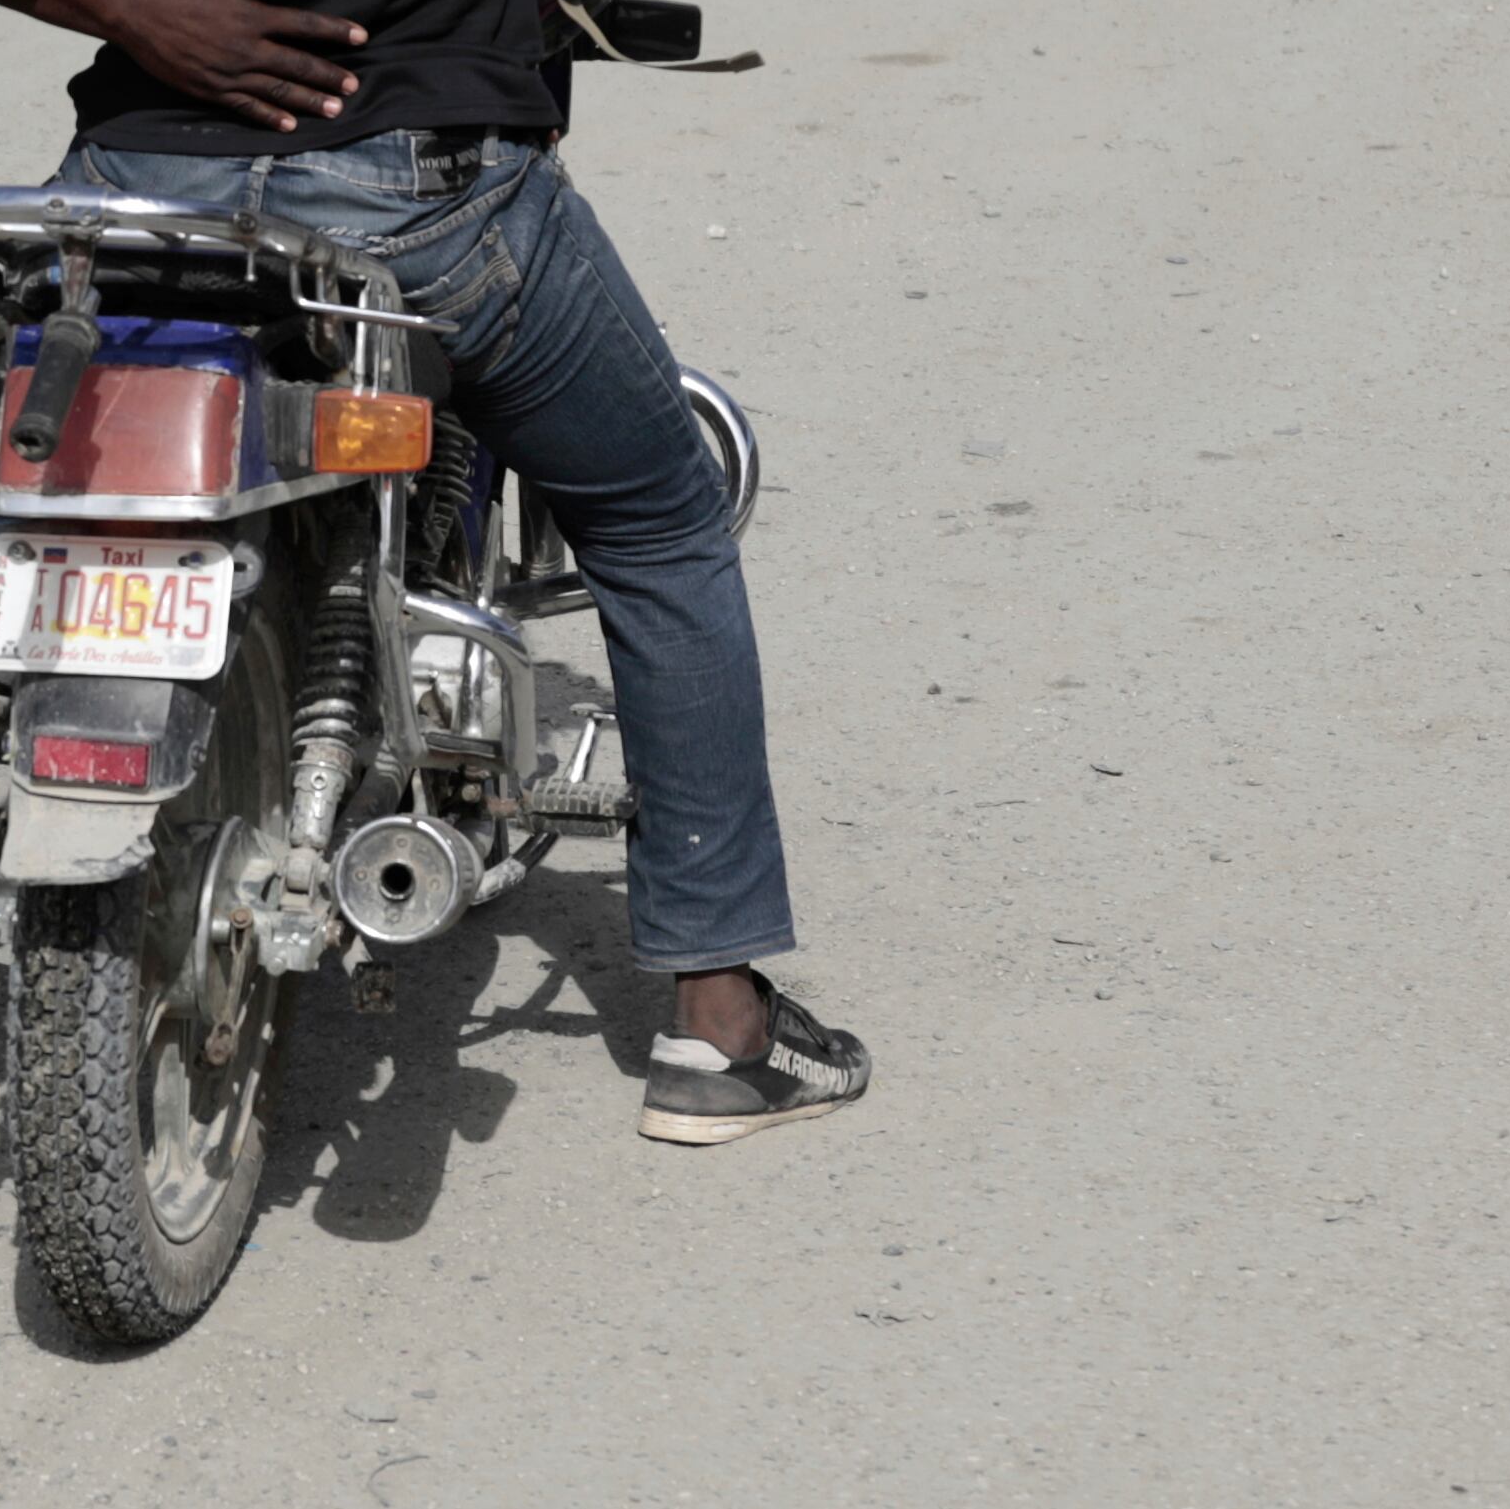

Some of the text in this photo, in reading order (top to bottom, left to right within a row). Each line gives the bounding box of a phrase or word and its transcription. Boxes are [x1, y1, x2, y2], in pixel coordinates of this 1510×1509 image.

[101, 547, 144, 566] Taxi
[57, 569, 214, 640] 04645
[27, 644, 45, 660] La
[82, 645, 107, 662] Des
[109, 646, 164, 665] Antilles
